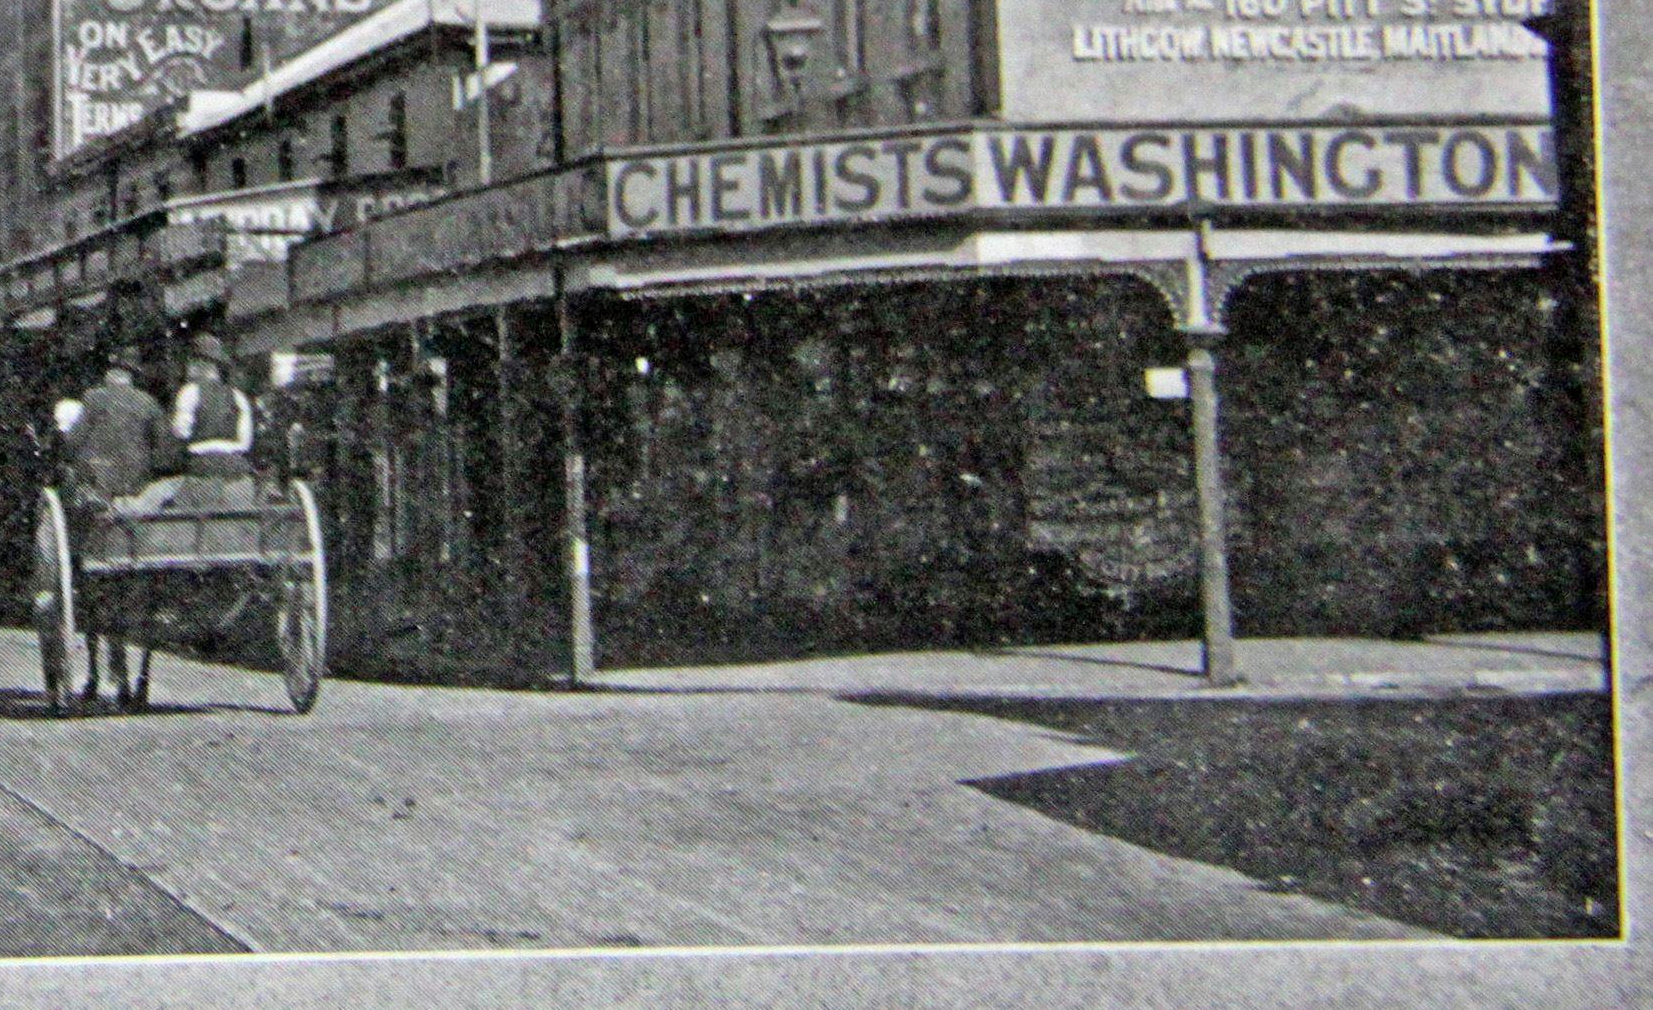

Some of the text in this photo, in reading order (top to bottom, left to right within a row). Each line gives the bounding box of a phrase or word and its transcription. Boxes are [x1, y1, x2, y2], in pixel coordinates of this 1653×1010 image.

[67, 23, 225, 92] VERY EASY
[78, 20, 129, 51] ON
[1210, 23, 1379, 60] NEWCASTLE
[614, 139, 974, 230] CHEMISTS
[987, 130, 1559, 204] WASHINGTON
